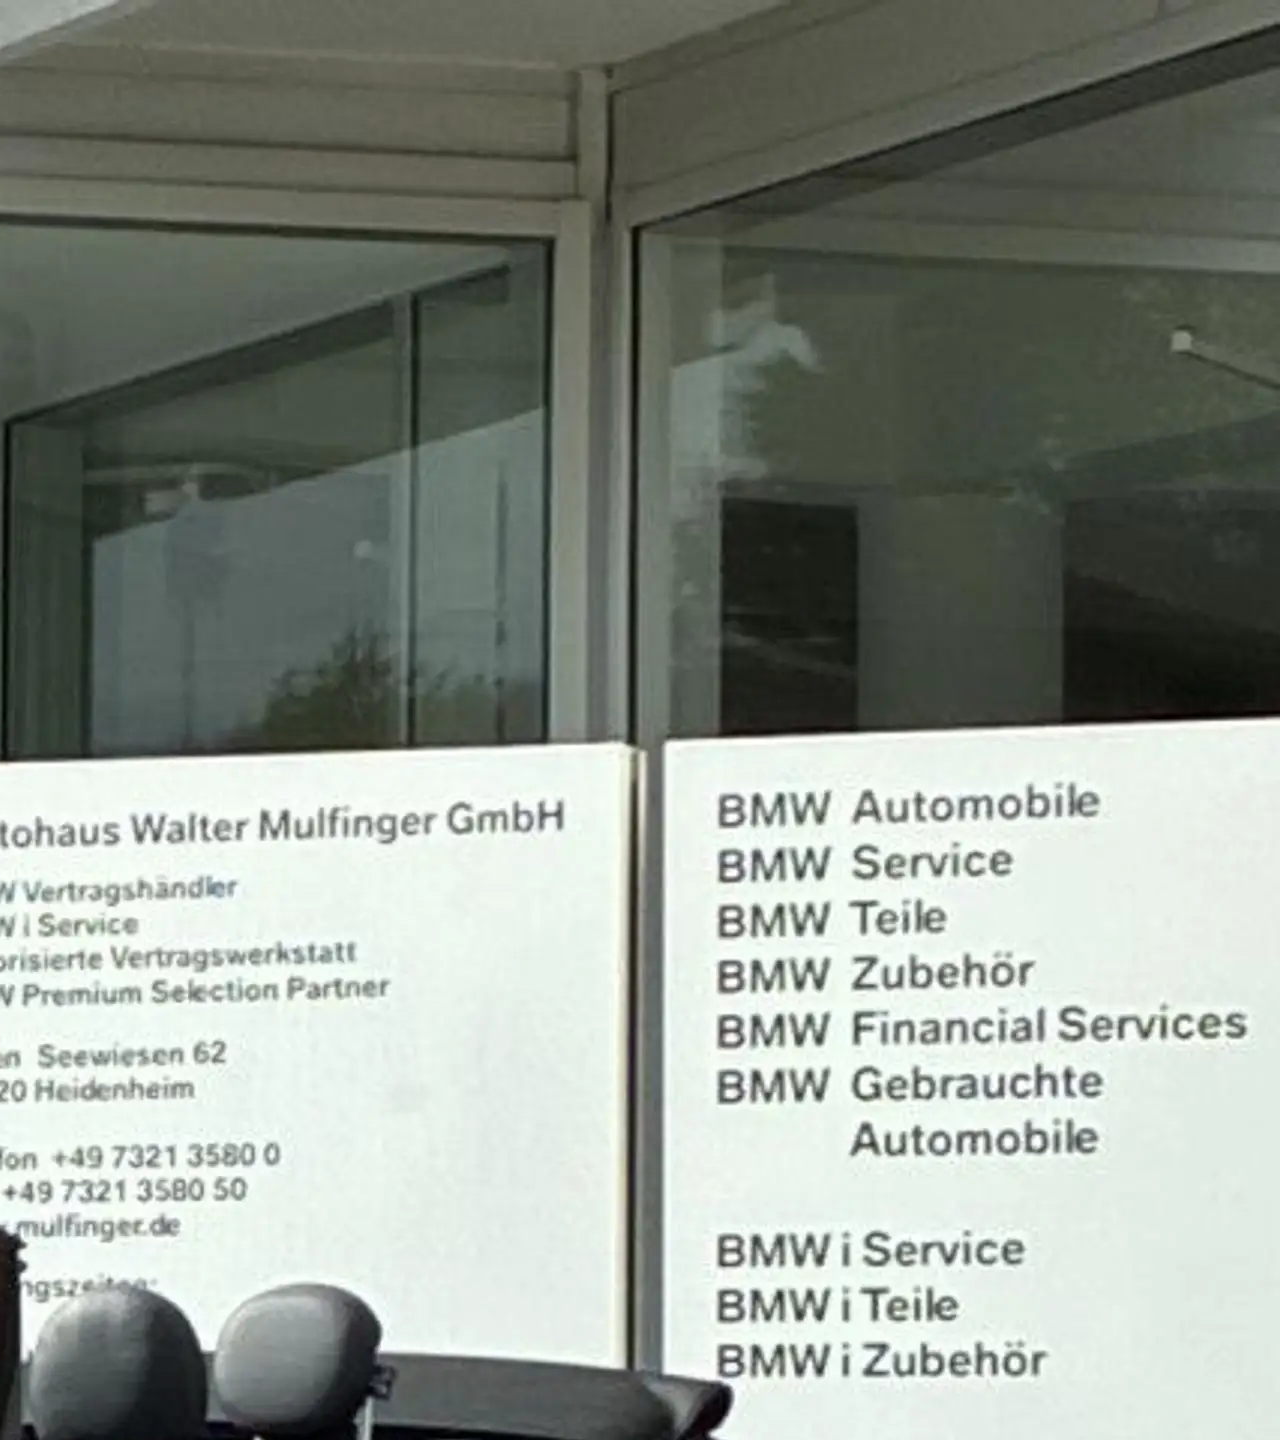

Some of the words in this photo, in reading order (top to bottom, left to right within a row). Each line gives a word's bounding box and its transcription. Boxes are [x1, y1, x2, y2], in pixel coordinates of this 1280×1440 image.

[128, 810, 251, 846] Walter
[258, 804, 439, 848] Mulfinger
[445, 798, 566, 837] GmbH
[716, 789, 834, 830] BMW
[850, 780, 1102, 827] Automobile
[716, 845, 834, 885] BMW
[850, 840, 1015, 882] Service
[21, 874, 239, 909] Vertragshändler
[21, 912, 32, 939] i
[36, 910, 140, 940] Service
[716, 900, 833, 941] BMW
[848, 896, 949, 938] Teile
[109, 938, 358, 975] Vertragswerkstatt
[716, 956, 833, 996] BMW
[850, 949, 1037, 993] Zubehör
[21, 979, 144, 1009] Premium
[150, 975, 281, 1005] Selection
[285, 973, 392, 1002] Partner
[716, 1010, 833, 1051] BMW
[851, 1005, 1048, 1048] Financial
[1056, 1002, 1250, 1046] Services
[36, 1039, 186, 1070] Seewiesen
[192, 1037, 229, 1066] 62
[33, 1075, 197, 1105] Heidenheim
[716, 1065, 833, 1106] BMW
[850, 1061, 1106, 1104] Gebrauchte
[50, 1144, 105, 1171] +49
[110, 1143, 178, 1170] 7321
[185, 1141, 256, 1169] 3580
[263, 1140, 283, 1168] 0
[848, 1117, 1101, 1159] Automobile
[1, 1179, 54, 1205] +49
[59, 1178, 127, 1205] 7321
[135, 1176, 206, 1204] 3580
[211, 1174, 250, 1203] 50
[716, 1232, 833, 1271] BMW
[840, 1229, 853, 1269] i
[861, 1228, 1028, 1269] Service
[716, 1286, 833, 1325] BMW
[840, 1284, 852, 1324] i
[857, 1284, 961, 1325] Teile
[716, 1342, 833, 1380] BMW
[840, 1340, 853, 1379] i
[860, 1337, 1051, 1379] Zubehör
